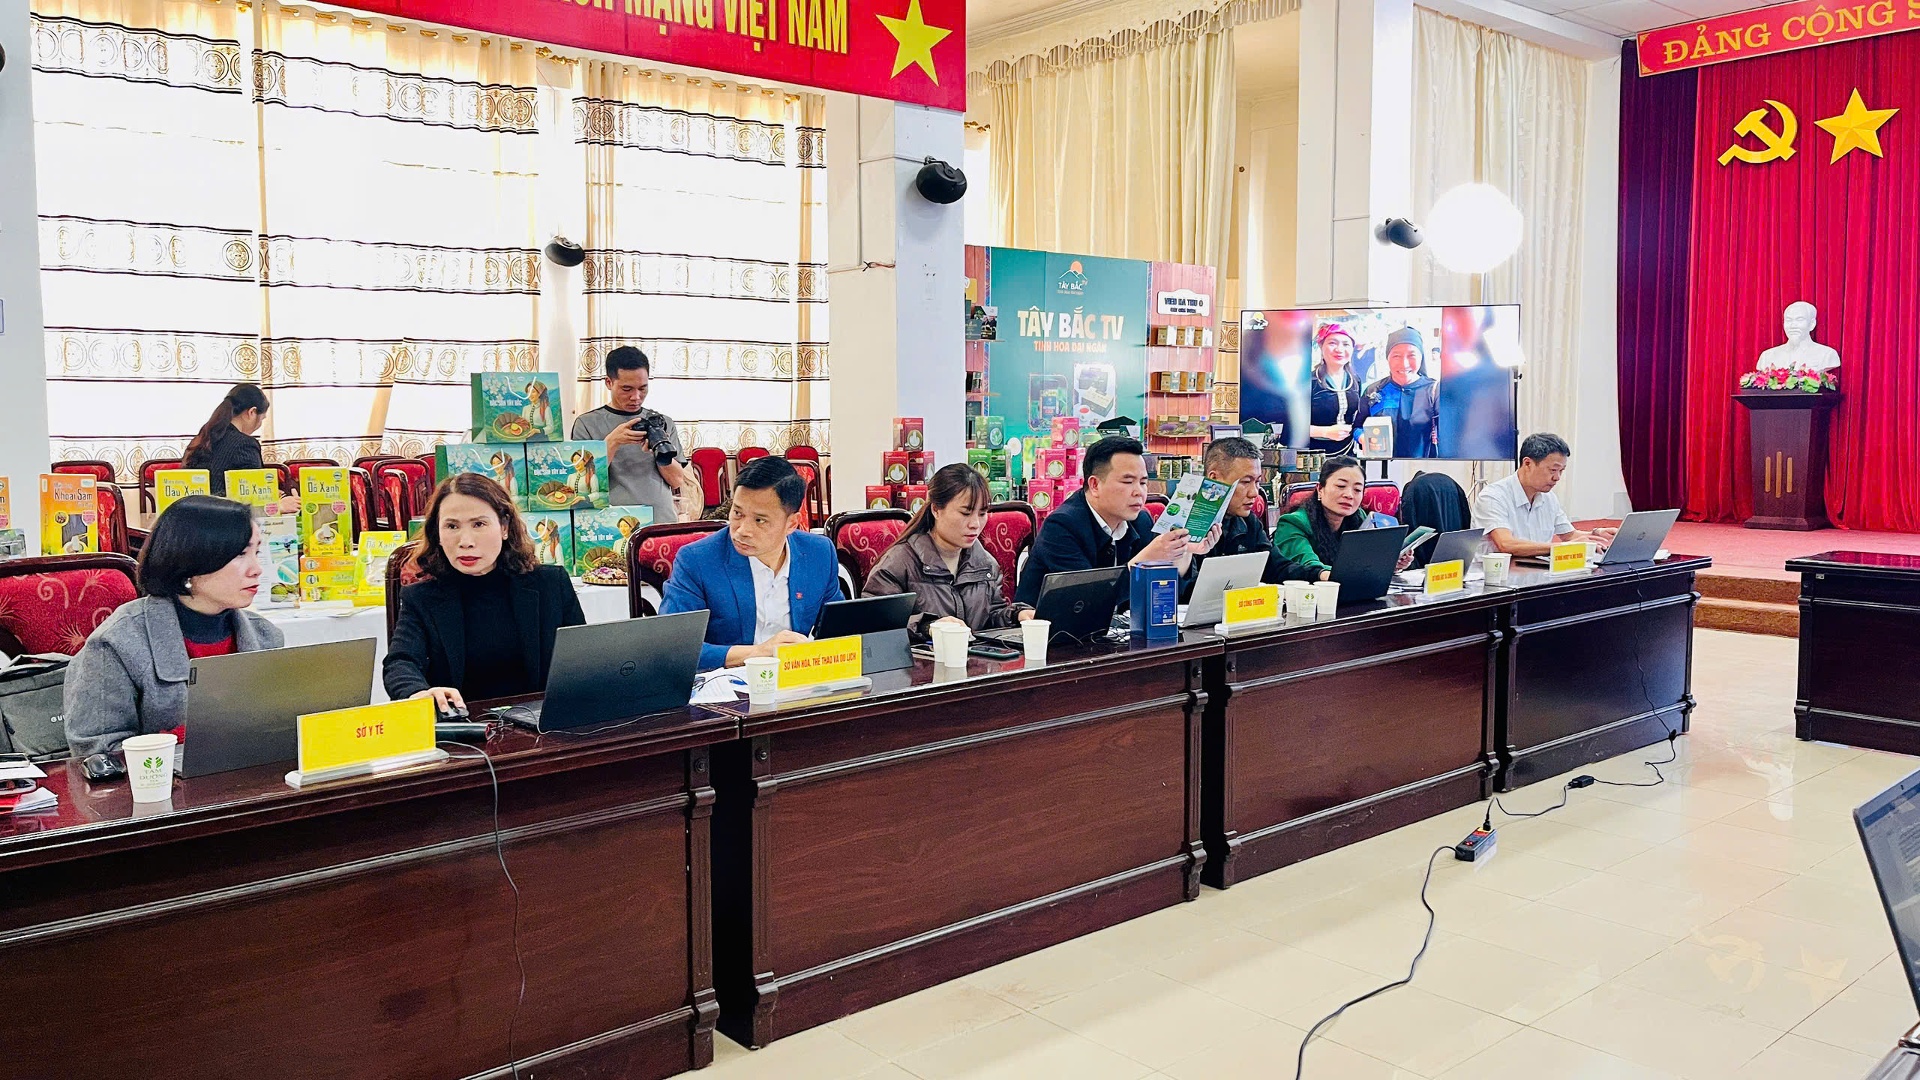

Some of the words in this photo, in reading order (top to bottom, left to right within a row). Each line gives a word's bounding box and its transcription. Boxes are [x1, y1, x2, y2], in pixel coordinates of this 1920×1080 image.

[788, 0, 847, 54] NAM
[1663, 24, 1771, 64] ĐẢNG
[1782, 0, 1896, 43] CỘNG
[1017, 305, 1055, 338] TÂY
[1058, 306, 1096, 339] BẮC
[1101, 315, 1124, 340] TV
[1053, 341, 1070, 352] HOA
[252, 484, 272, 495] Xanh
[320, 481, 340, 493] Xanh
[356, 722, 366, 738] SỞ
[369, 725, 373, 737] Y
[375, 721, 384, 735] TẾ
